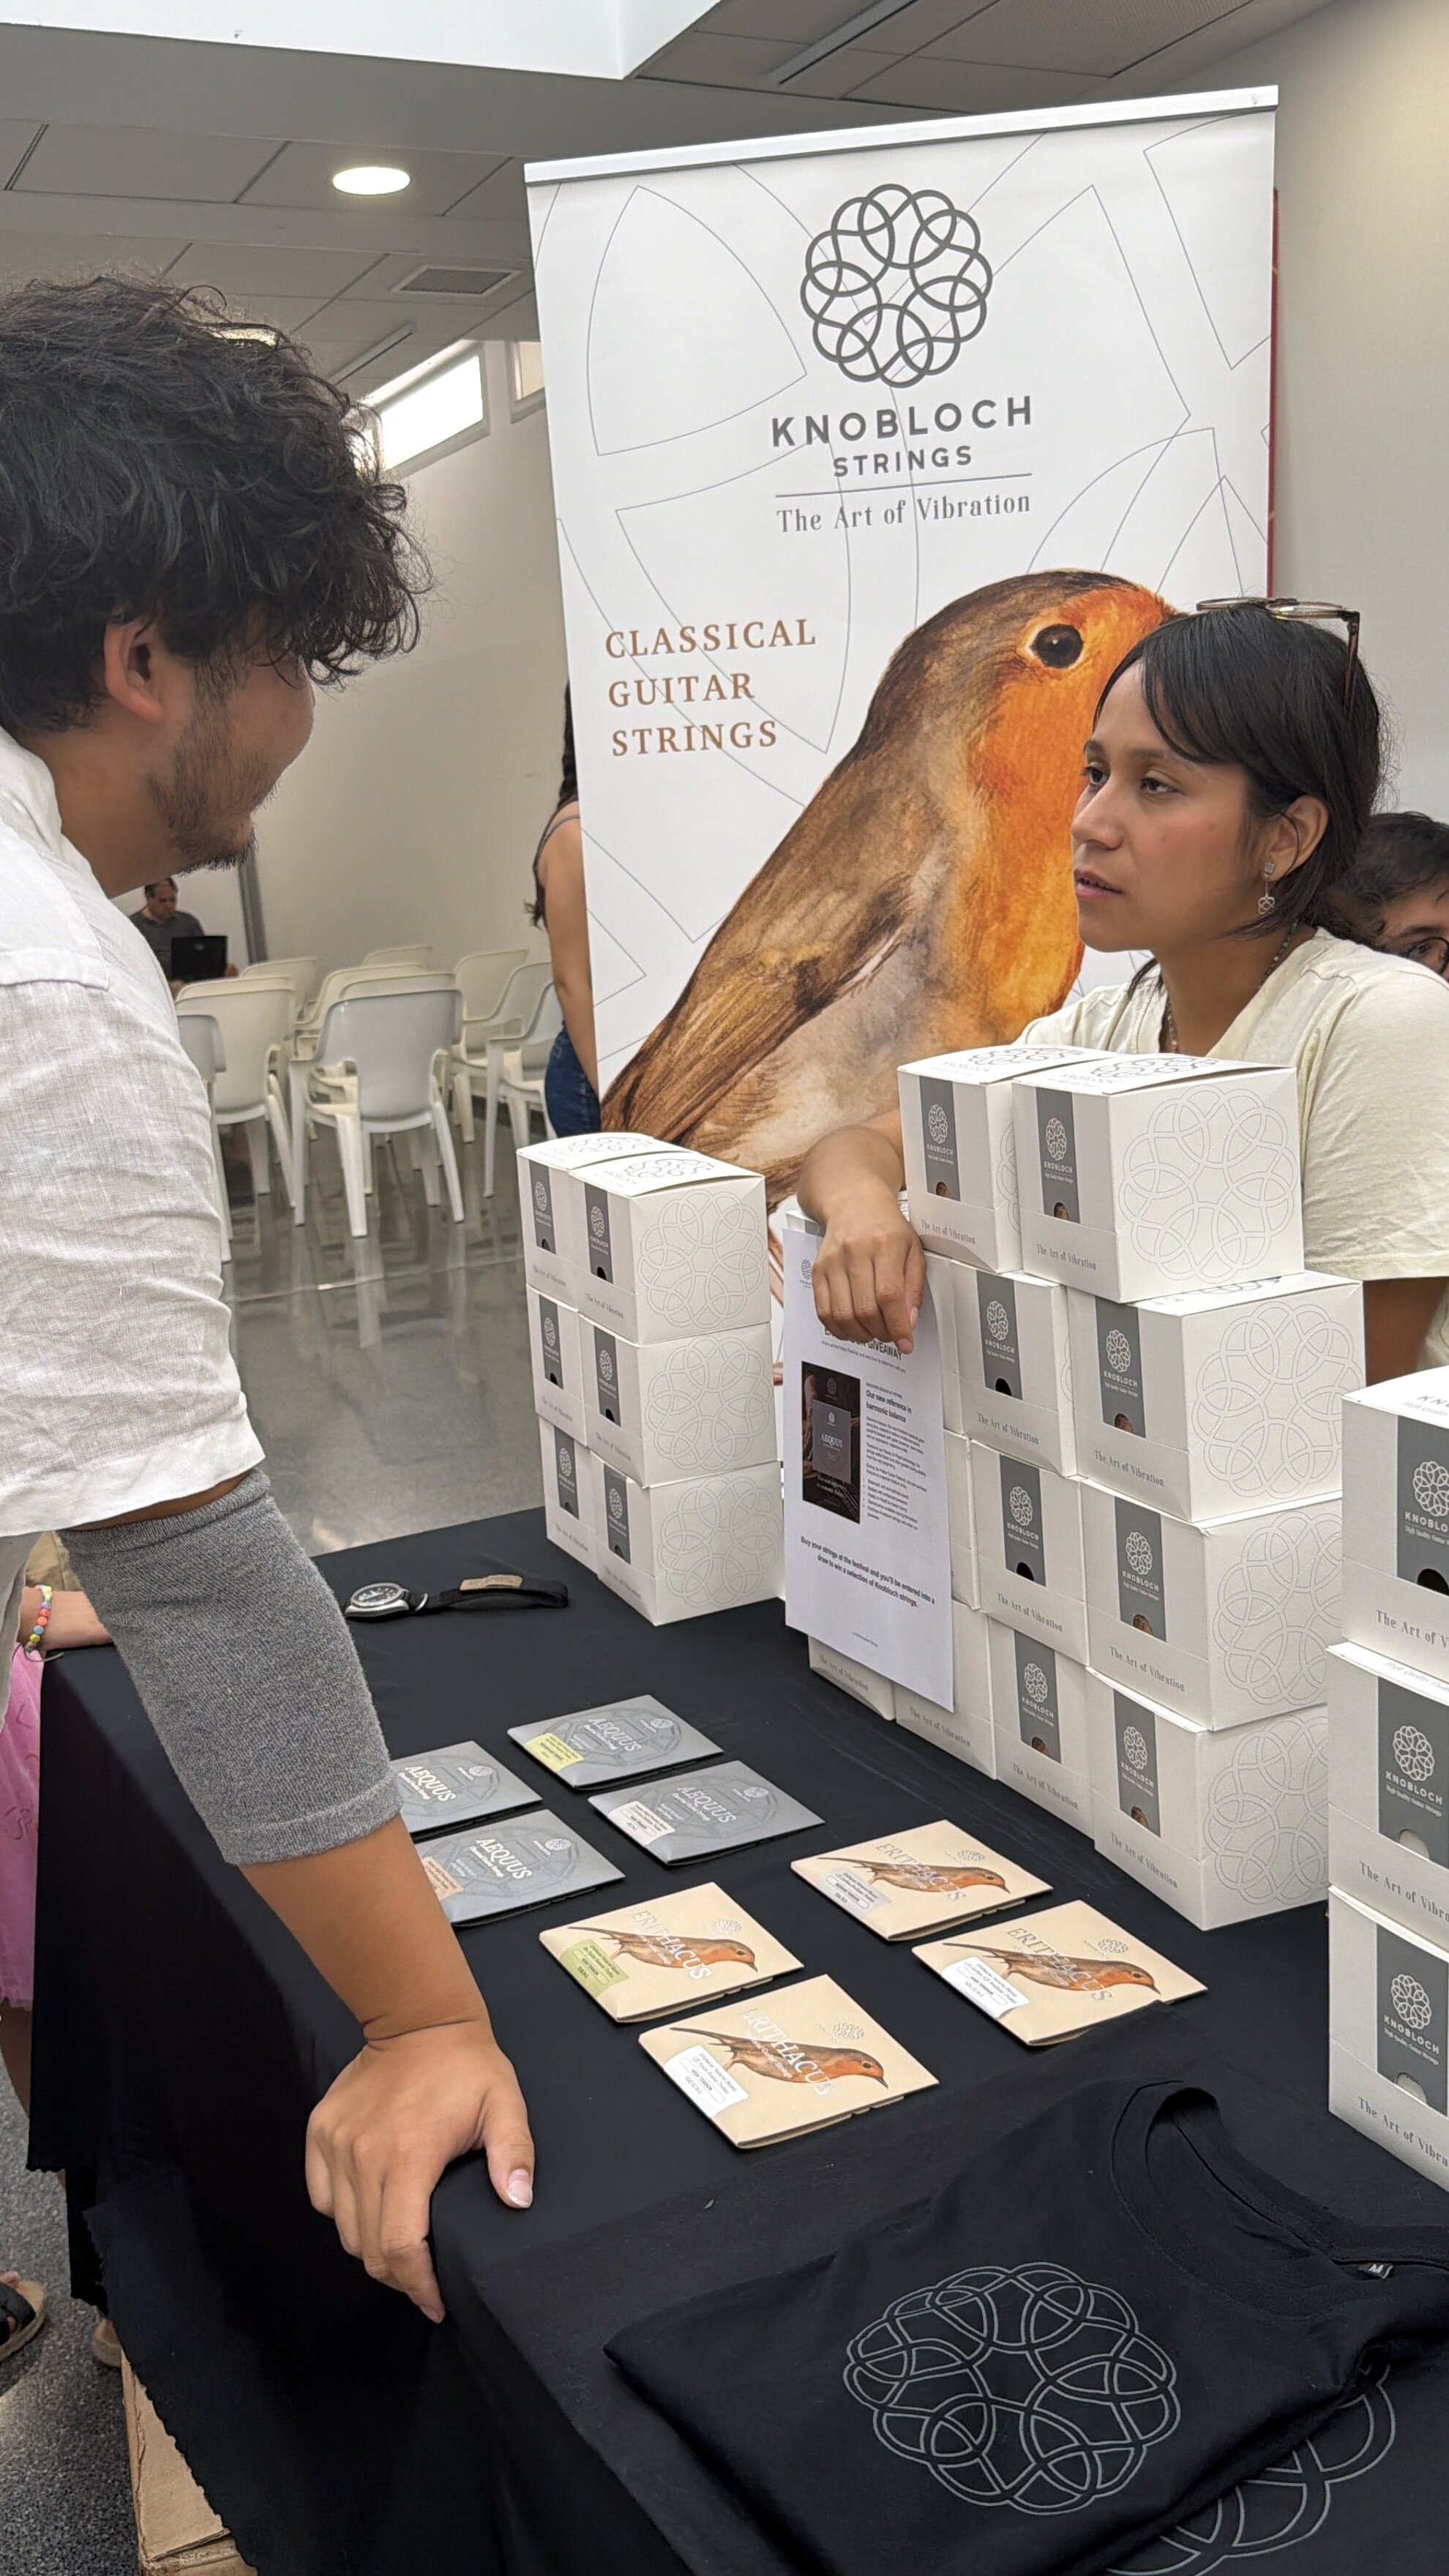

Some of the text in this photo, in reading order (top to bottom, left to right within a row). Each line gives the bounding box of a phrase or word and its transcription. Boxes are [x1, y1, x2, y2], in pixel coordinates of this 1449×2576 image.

[772, 396, 1032, 447] KNOBLOCH
[833, 445, 972, 477] STRINGS
[776, 494, 1030, 533] The Art of Vibration
[605, 618, 816, 658] CLASSICAL
[609, 673, 755, 708] GUITAR
[613, 720, 777, 757] STRINGS
[1044, 1162, 1073, 1173] KNOBLOCH
[921, 1218, 976, 1245] The Art of Vibration
[1037, 1243, 1096, 1271] The Art of Vibration
[985, 1339, 1015, 1353] KNOBLOCH
[1104, 1371, 1137, 1388] KNOBLOCH
[978, 1412, 1039, 1445] The Art of Vibration
[1095, 1450, 1164, 1488] The Art of Vibration
[1007, 1522, 1039, 1540] KNOBLOCH
[801, 1535, 810, 1548] Buy
[812, 1541, 821, 1553] your
[823, 1546, 837, 1560] strings
[853, 1559, 869, 1573] festival
[870, 1568, 879, 1579] and
[902, 1582, 920, 1598] entered
[921, 1591, 931, 1603] into
[817, 1554, 828, 1565] draw
[847, 1568, 868, 1584] selection
[875, 1581, 898, 1599] Knobloch
[1122, 1570, 1159, 1592] KNOBLOCH
[997, 1592, 1063, 1633] The Art of Vibration
[1376, 1609, 1396, 1630] The
[1402, 1620, 1420, 1640] Art
[1425, 1628, 1436, 1647] of
[1110, 1645, 1185, 1693] The Art of Vibration
[910, 1706, 920, 1720] The
[935, 1720, 940, 1731] of
[1022, 1697, 1054, 1718] KNOBLOCH
[588, 1718, 642, 1752] AEQUUS
[405, 1766, 456, 1802] AEQUUS
[1013, 1761, 1023, 1778] The
[1027, 1770, 1036, 1785] Art
[1039, 1778, 1044, 1790] of
[1121, 1761, 1153, 1787] KNOBLOCH
[1385, 1771, 1442, 1805] KNOBLOCH
[677, 1786, 737, 1823] AEQUUS
[476, 1838, 533, 1879] AEQUUS
[1111, 1832, 1177, 1890] The Art of Vibration
[1359, 1860, 1379, 1883] The
[1384, 1875, 1401, 1896] Art
[1406, 1887, 1417, 1905] of
[742, 2008, 835, 2096] ERITHACUS
[1384, 2015, 1439, 2054] KNOBLOCH
[1358, 2095, 1377, 2121] The
[1383, 2113, 1399, 2136] Art
[1404, 2126, 1414, 2146] of
[1368, 2264, 1384, 2273] M
